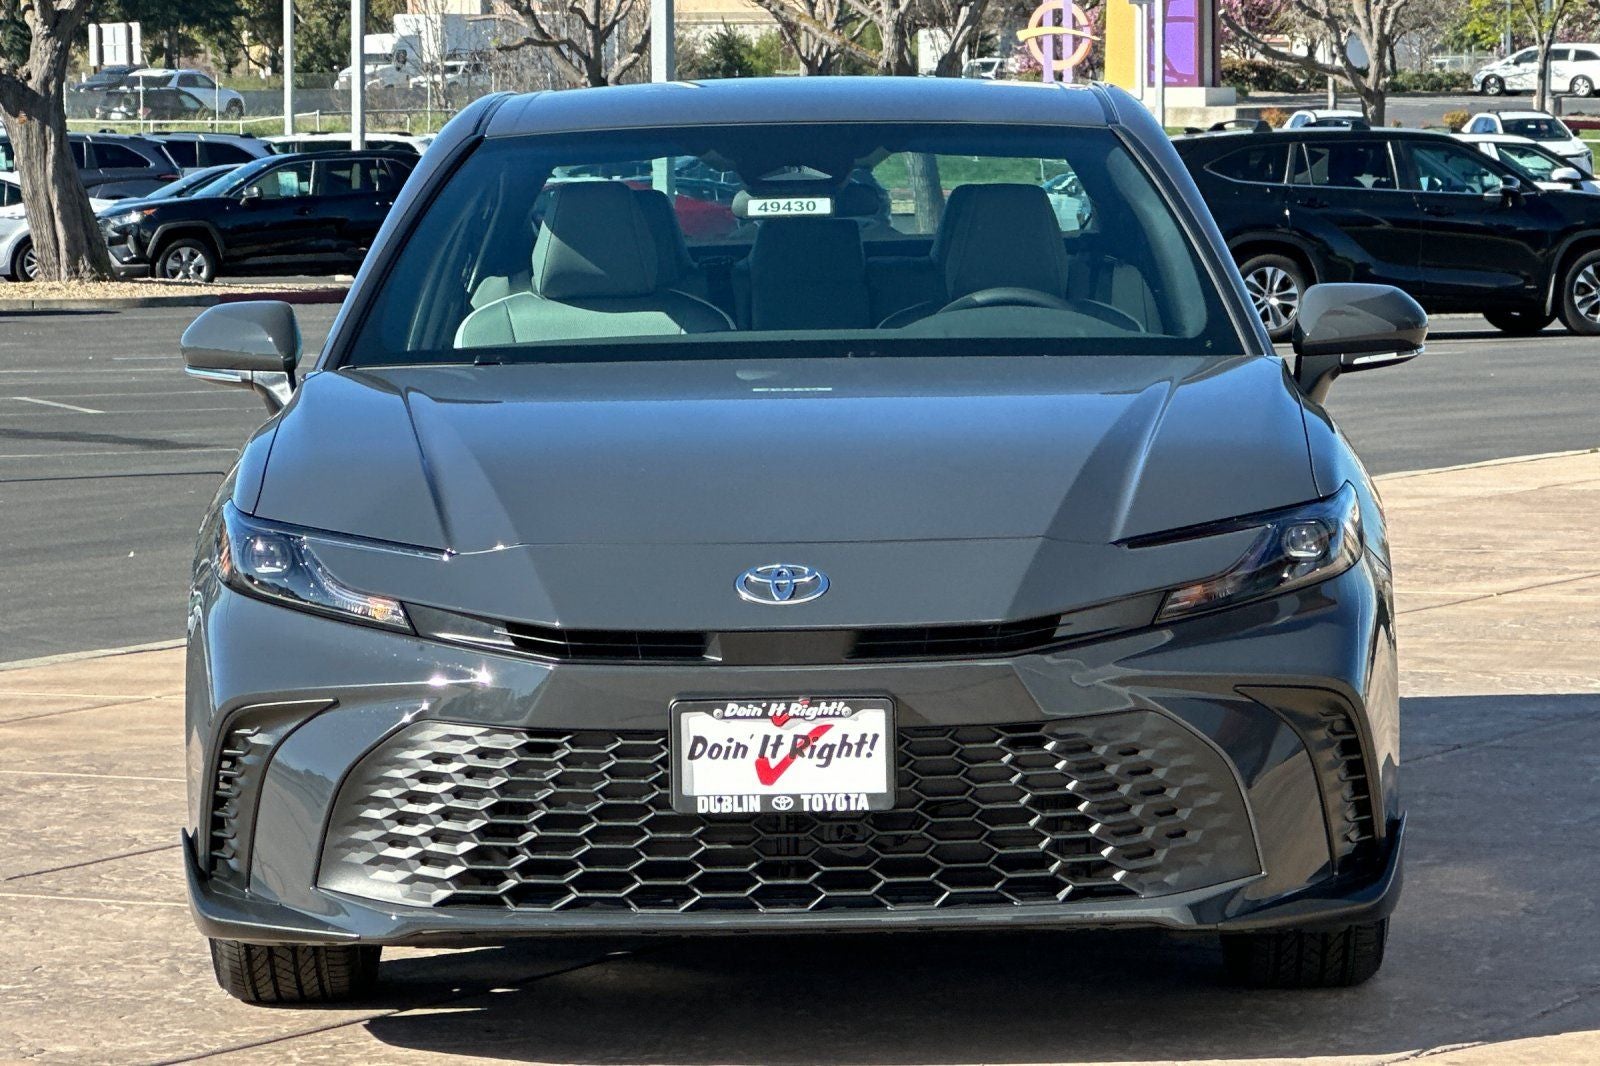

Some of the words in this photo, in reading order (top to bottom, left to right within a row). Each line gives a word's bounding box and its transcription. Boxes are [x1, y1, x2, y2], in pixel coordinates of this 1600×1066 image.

[757, 200, 817, 213] 49430
[724, 703, 766, 718] Doin'
[768, 703, 786, 717] It
[787, 702, 844, 720] Right!
[687, 734, 754, 761] Doin'
[758, 734, 785, 760] It
[790, 732, 880, 769] Right!
[697, 796, 761, 813] DUBLIN
[800, 794, 870, 811] TOYOTA
